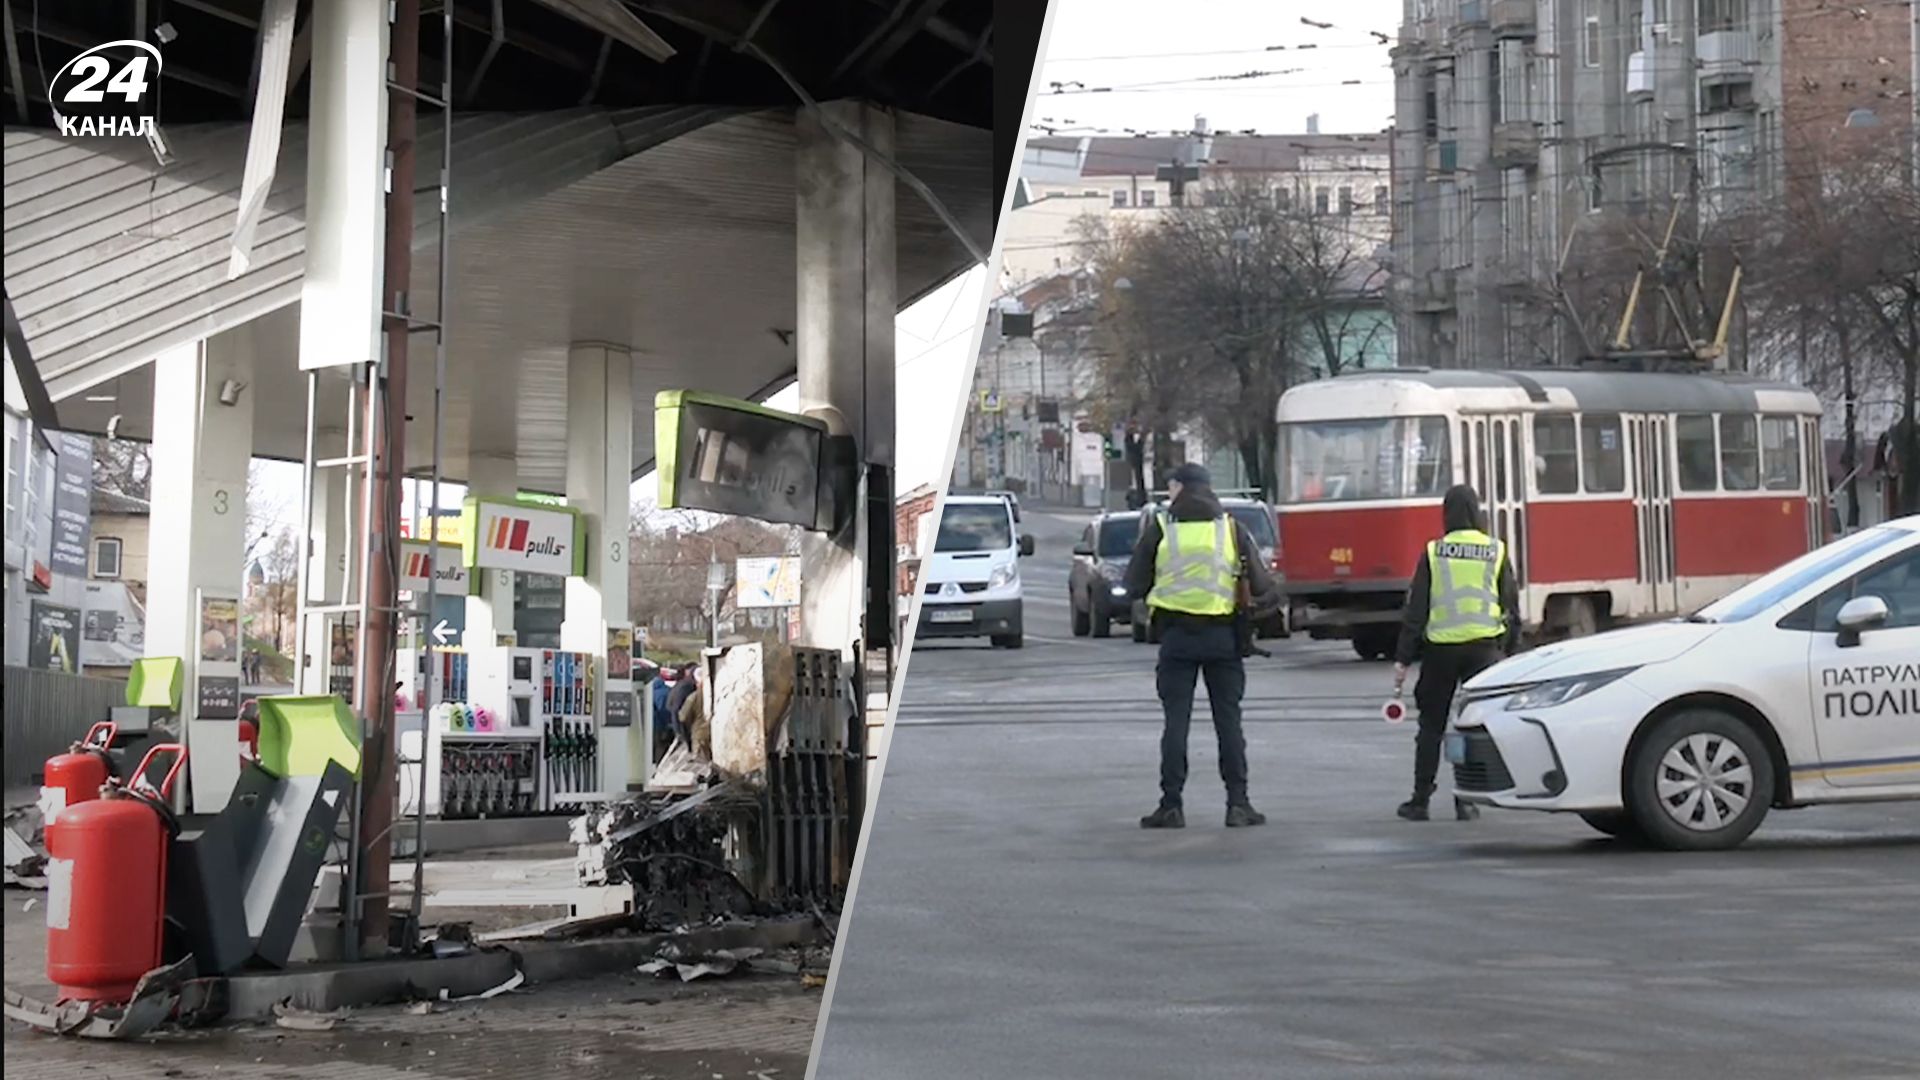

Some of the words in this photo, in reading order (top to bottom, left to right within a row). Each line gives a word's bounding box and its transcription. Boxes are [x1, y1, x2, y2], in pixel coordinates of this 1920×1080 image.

[213, 489, 229, 515] 3
[525, 536, 565, 558] pulls
[610, 541, 621, 562] 3
[500, 569, 509, 586] 5
[1823, 664, 1920, 686] ПАТРУЛ
